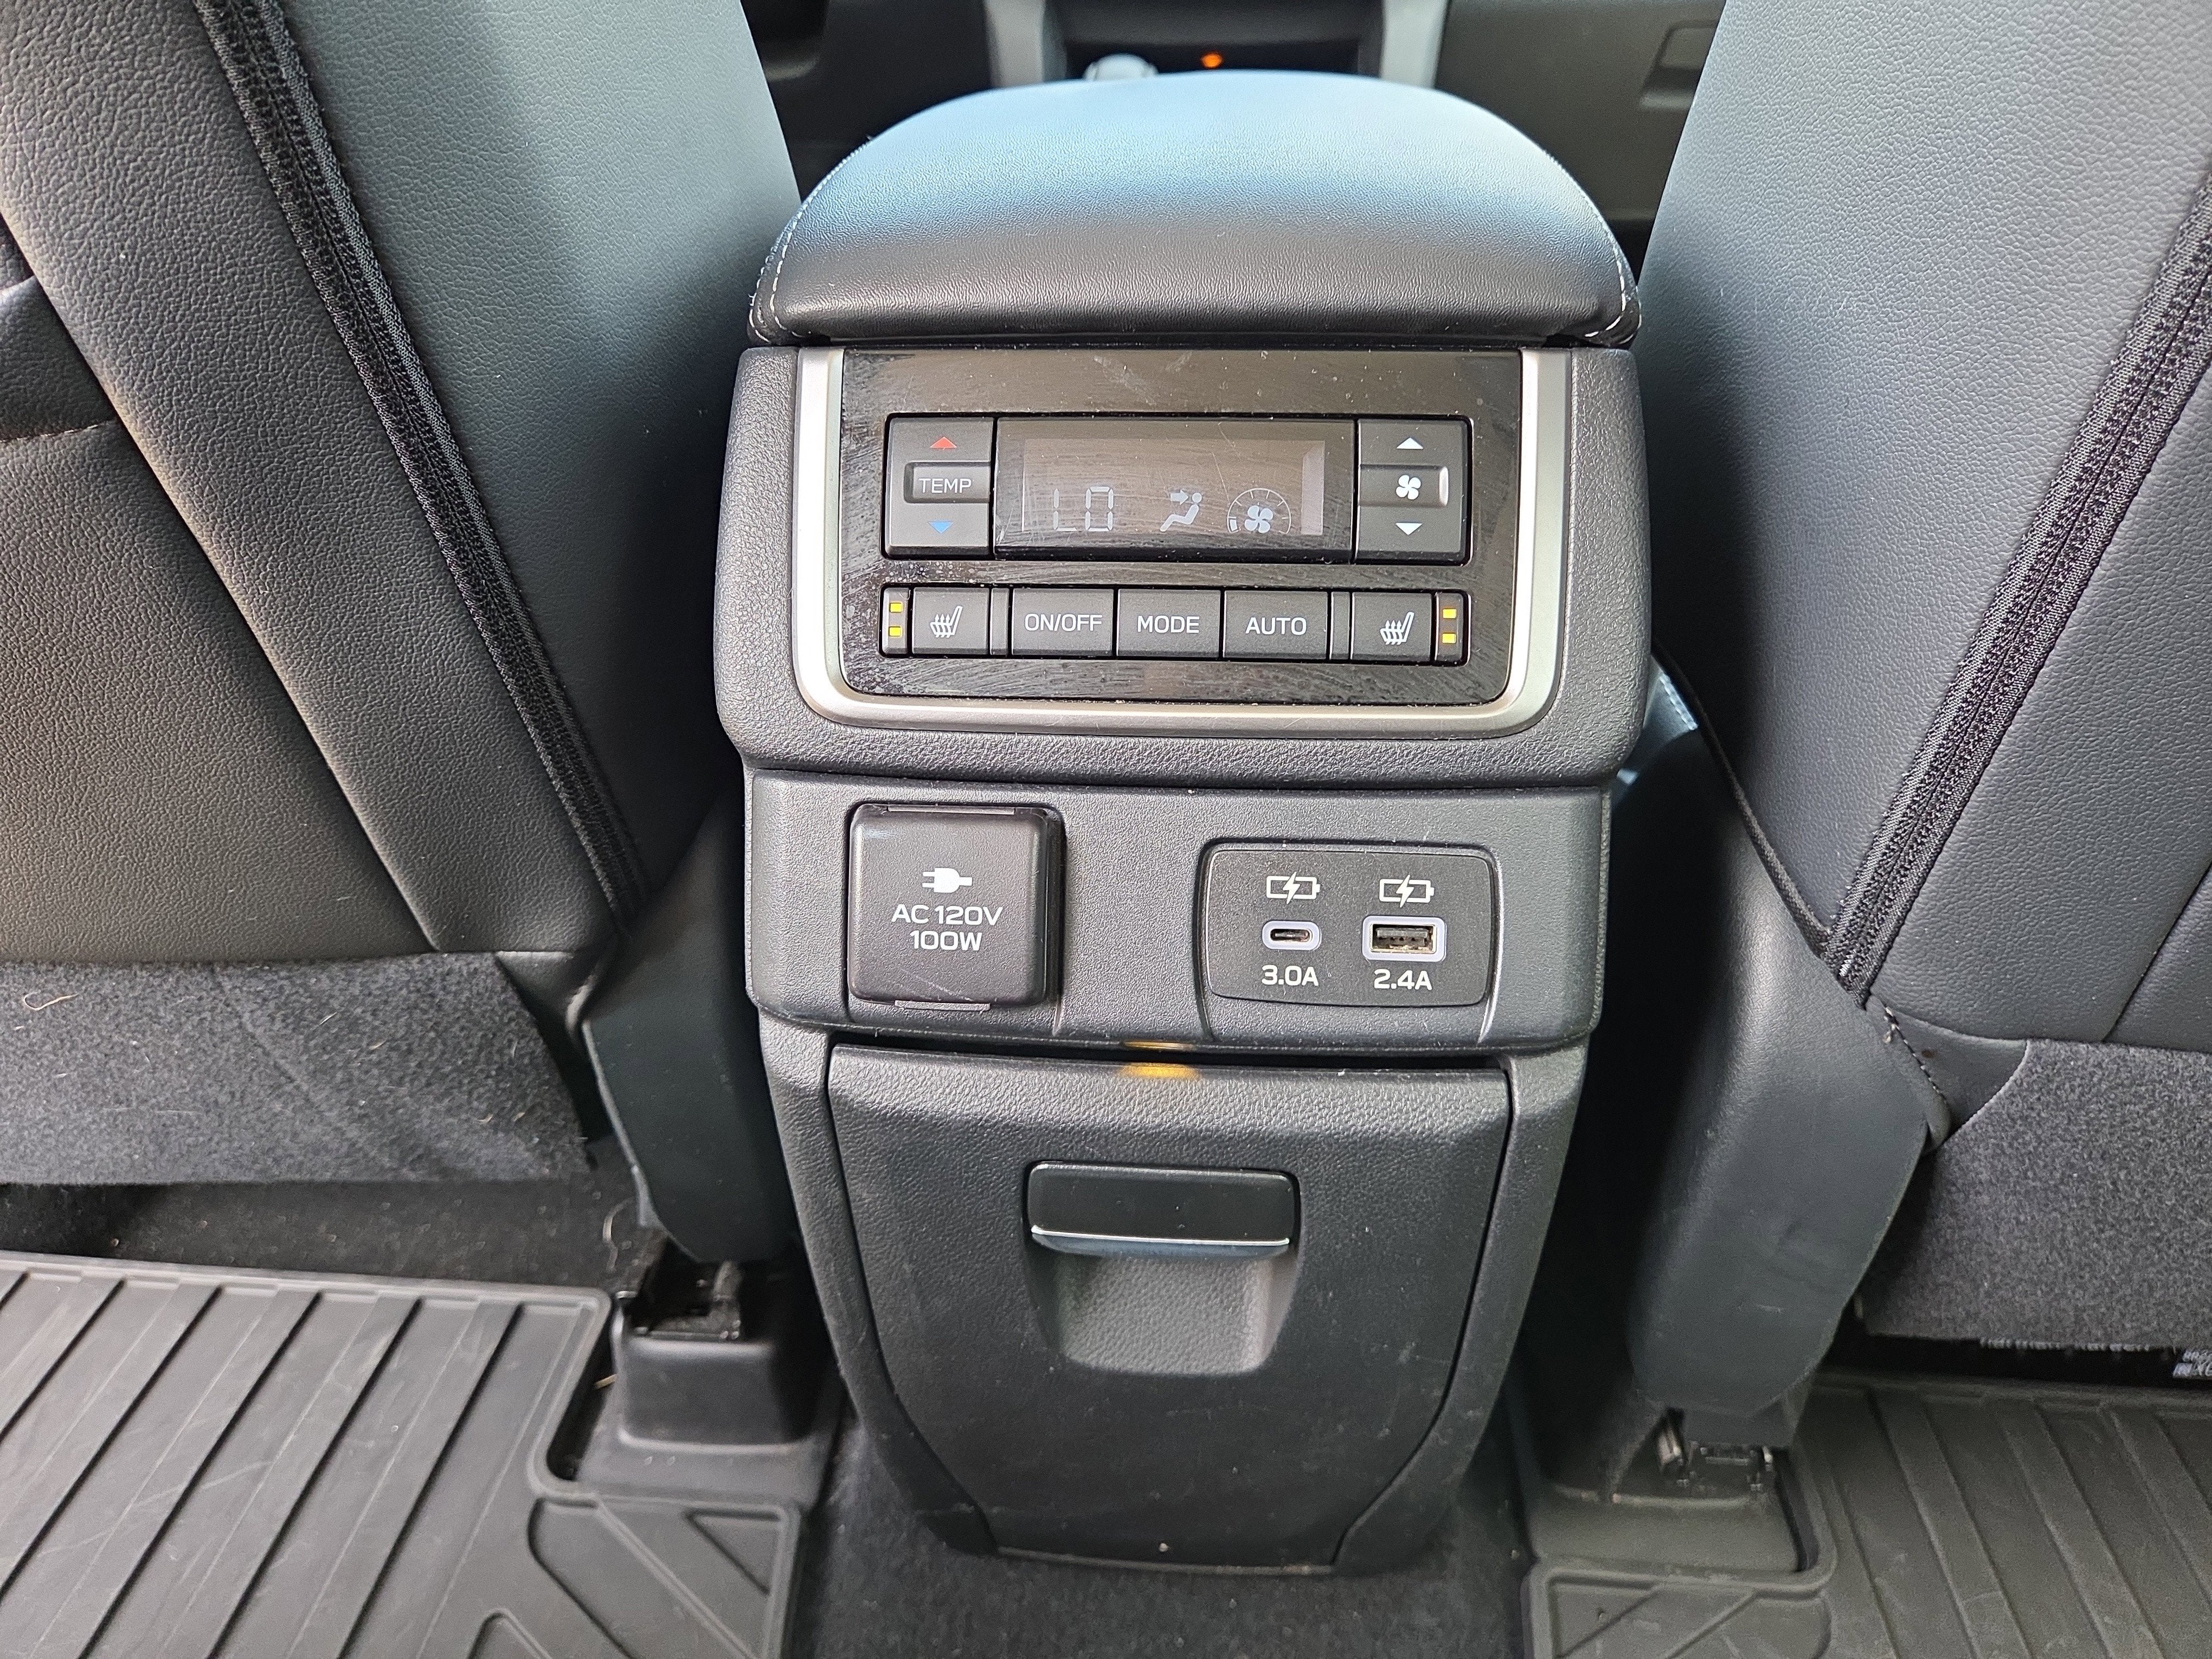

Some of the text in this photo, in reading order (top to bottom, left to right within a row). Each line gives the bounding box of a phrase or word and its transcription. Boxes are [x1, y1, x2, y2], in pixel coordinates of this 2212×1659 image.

[918, 478, 972, 494] TEMP
[1024, 613, 1103, 632] ON/OFF
[1137, 615, 1200, 634] MODE
[1245, 616, 1307, 636] AUTO
[891, 903, 1004, 927] AC 120V
[909, 929, 982, 951] 100W
[1261, 964, 1320, 987] 3.0A
[1373, 968, 1433, 991] 2.4A
